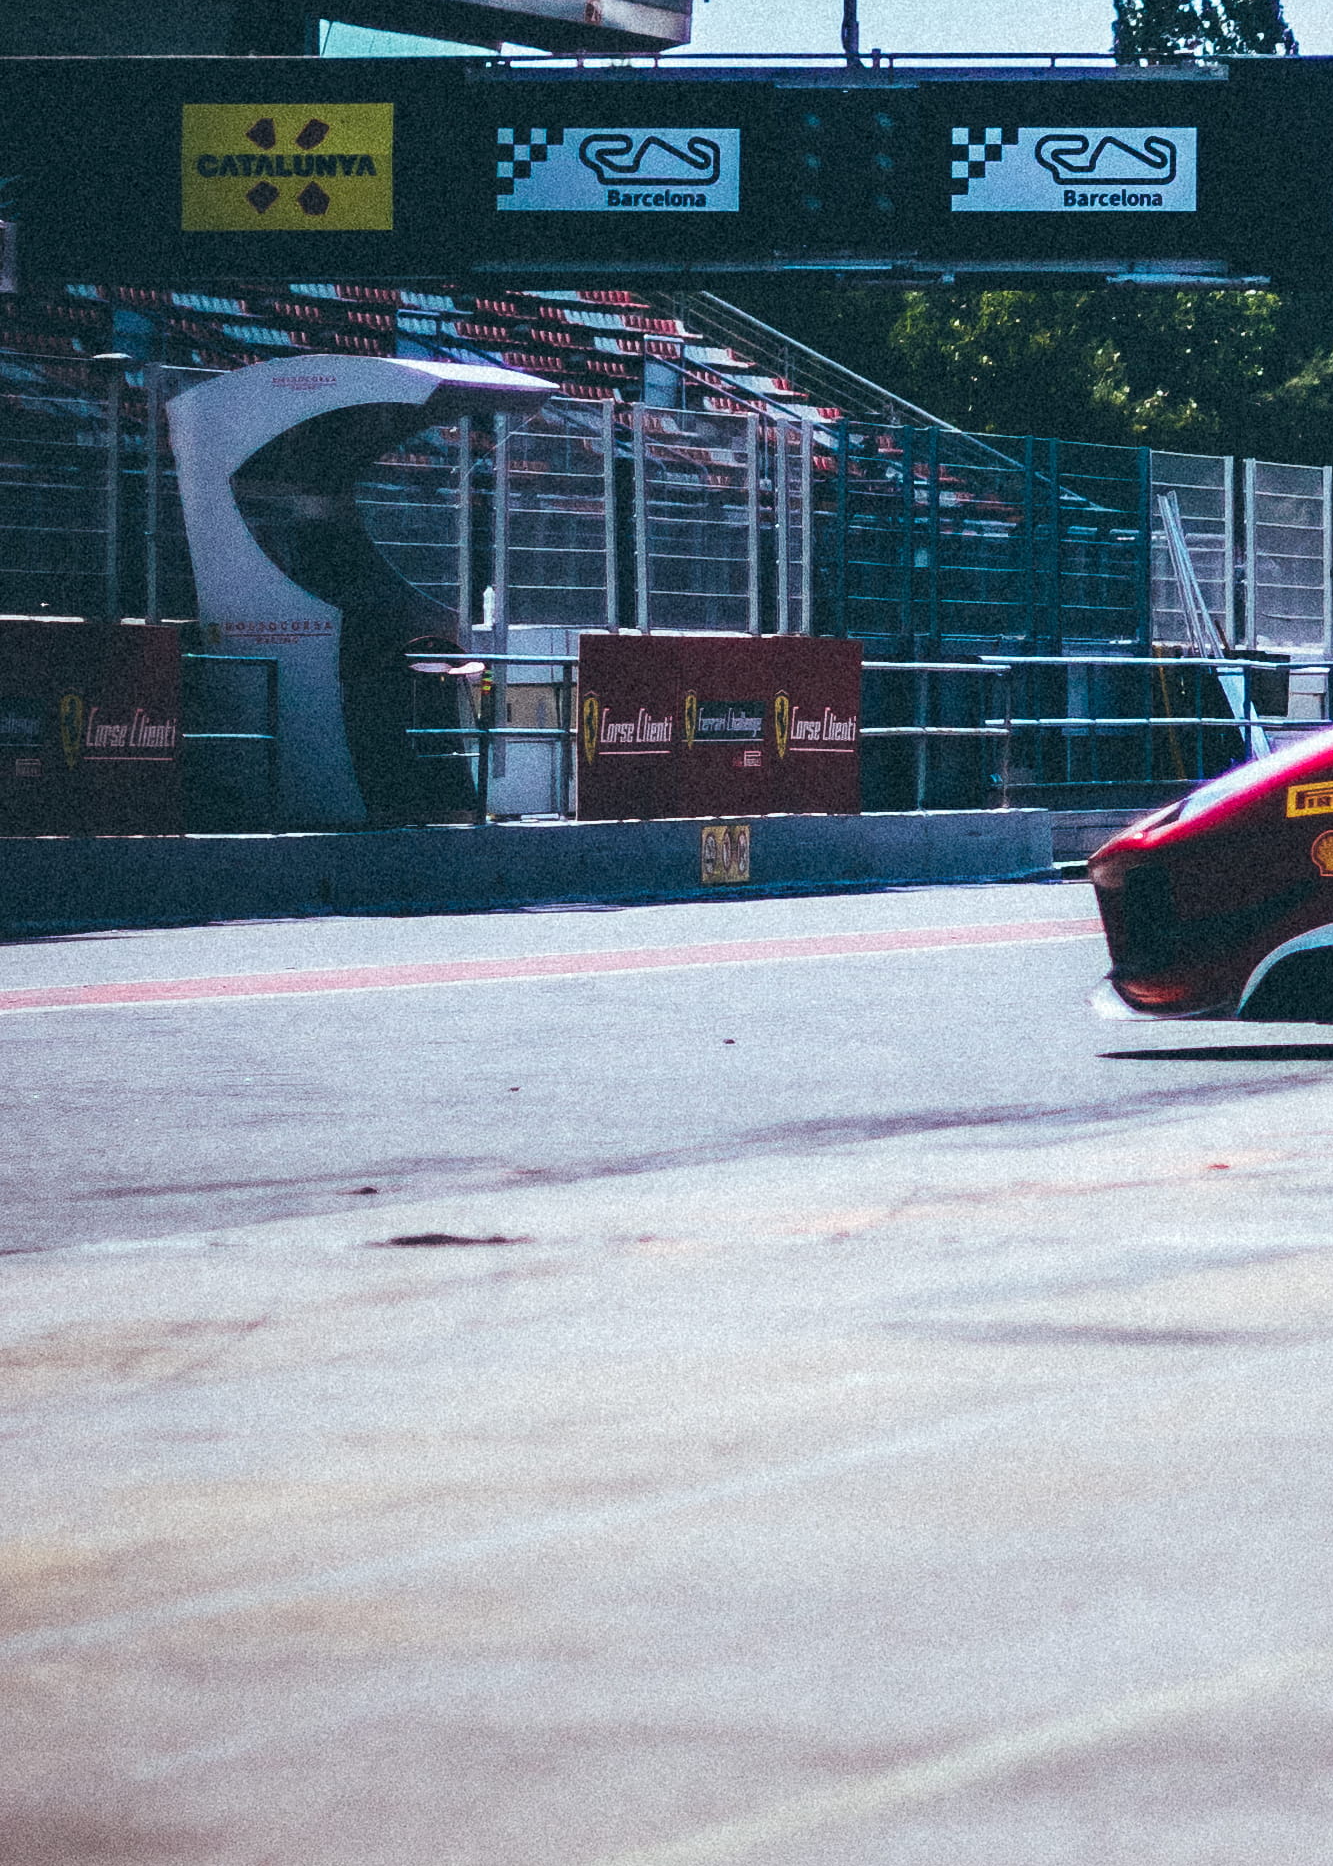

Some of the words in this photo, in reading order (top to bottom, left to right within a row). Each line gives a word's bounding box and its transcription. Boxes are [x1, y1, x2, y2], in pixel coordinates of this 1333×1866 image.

[197, 154, 377, 178] CATALUNYA
[607, 189, 707, 207] Barcelona
[1063, 189, 1163, 207] Barcelona
[85, 707, 128, 747] Corse
[129, 708, 177, 747] Clienti
[600, 708, 634, 743] Corse
[637, 707, 673, 743] Clienti
[790, 707, 820, 740] Corse
[822, 707, 857, 741] Clienti
